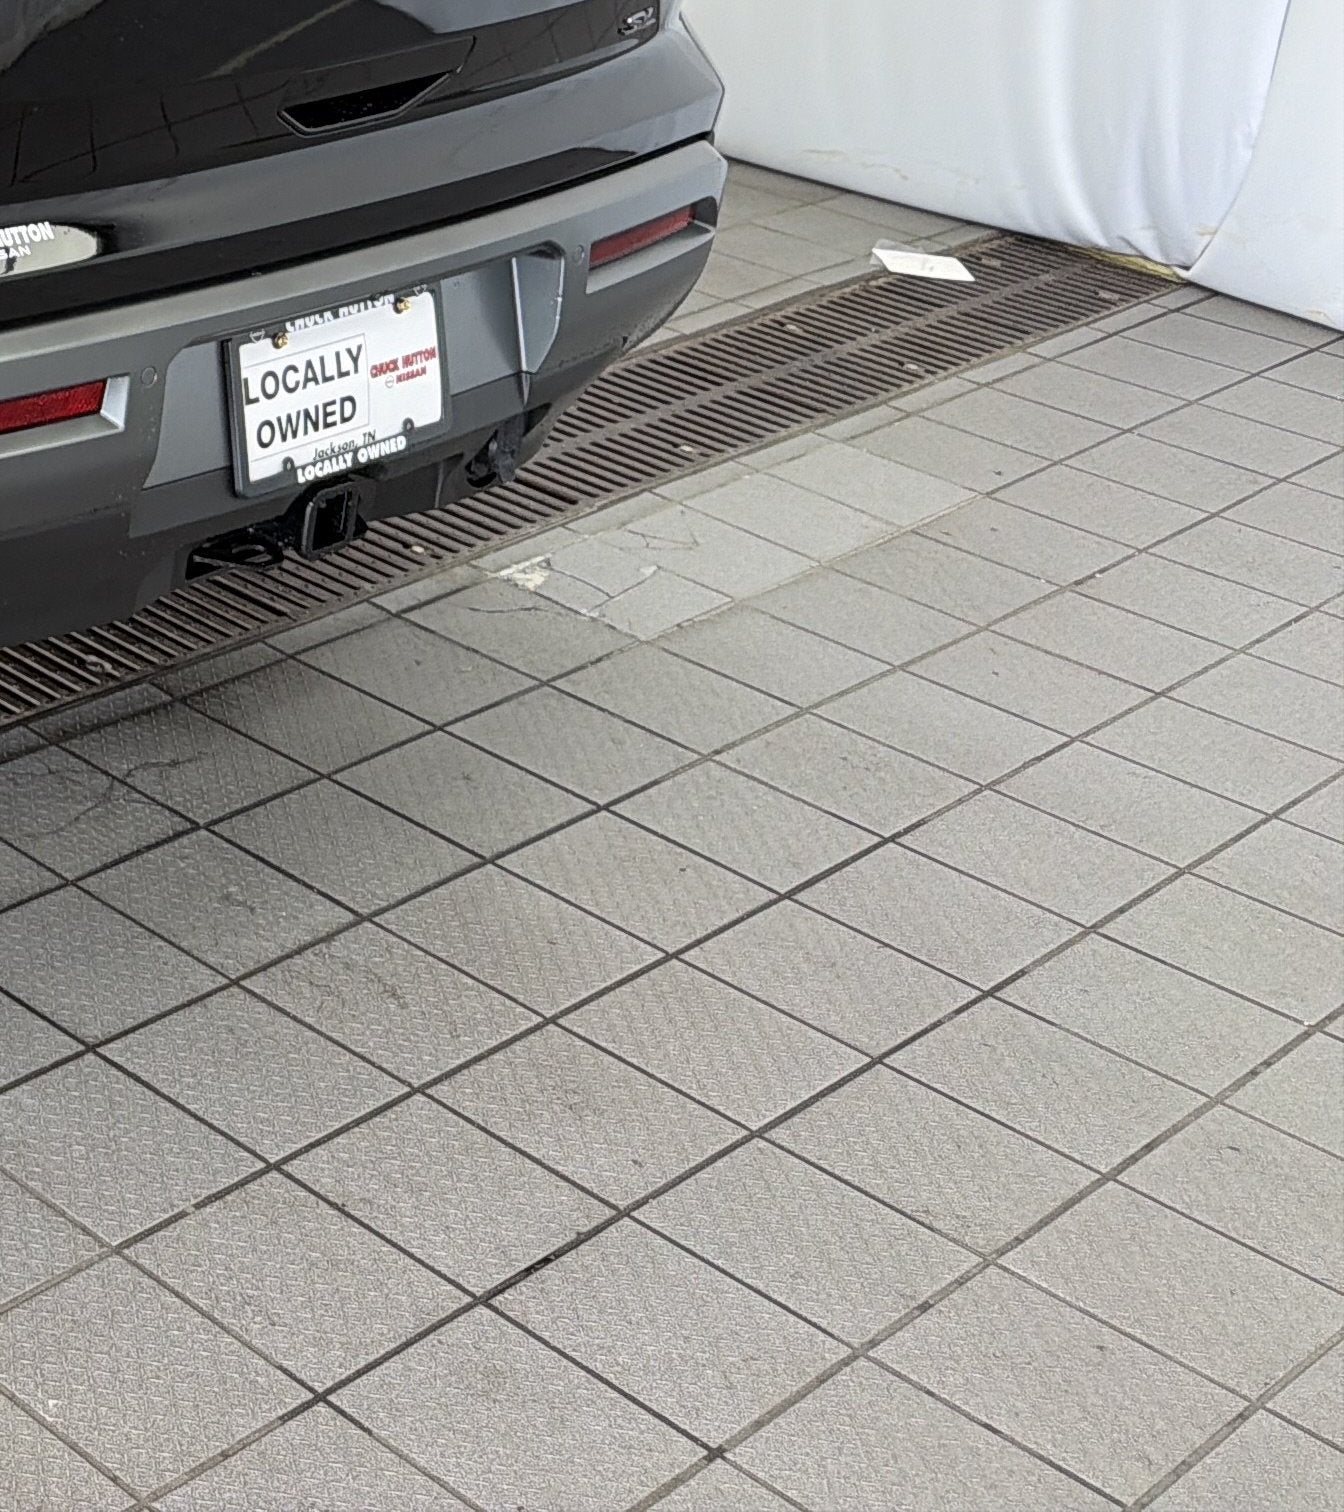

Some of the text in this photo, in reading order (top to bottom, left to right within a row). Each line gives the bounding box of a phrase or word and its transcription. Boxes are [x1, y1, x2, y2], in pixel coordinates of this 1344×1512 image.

[242, 343, 363, 406] LOCALLY
[370, 345, 437, 379] CHUCK HUTTON
[395, 366, 427, 385] NISSAN
[256, 395, 357, 449] OWNED
[296, 435, 407, 484] LOCALLY OWNED
